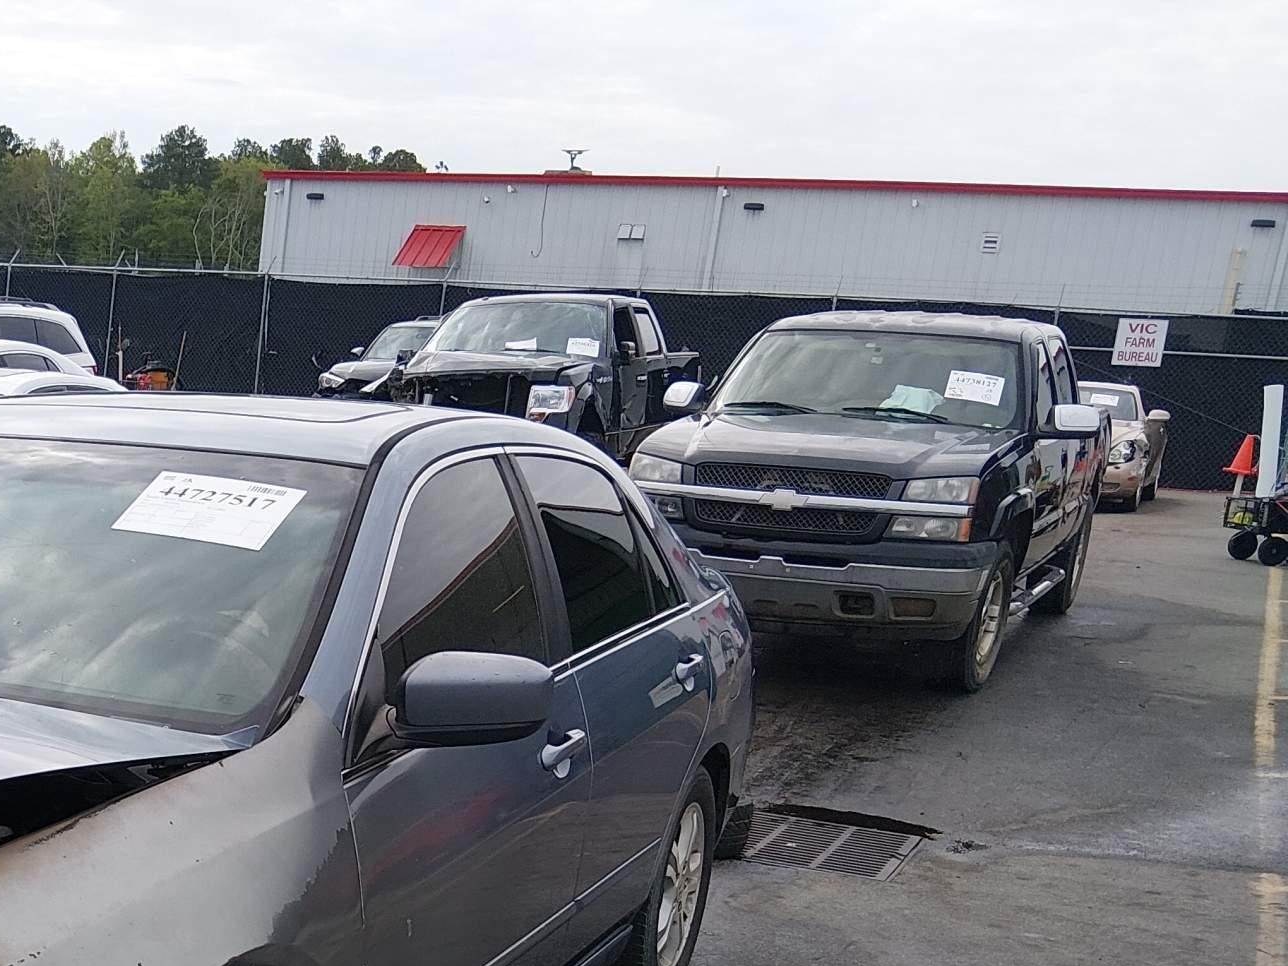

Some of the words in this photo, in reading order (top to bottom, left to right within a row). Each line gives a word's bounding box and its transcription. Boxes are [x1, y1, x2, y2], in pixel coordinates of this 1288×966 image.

[1128, 323, 1158, 334] VIC
[1124, 336, 1156, 348] FARM
[1117, 350, 1158, 363] BUREAU
[159, 485, 278, 510] 44727517
